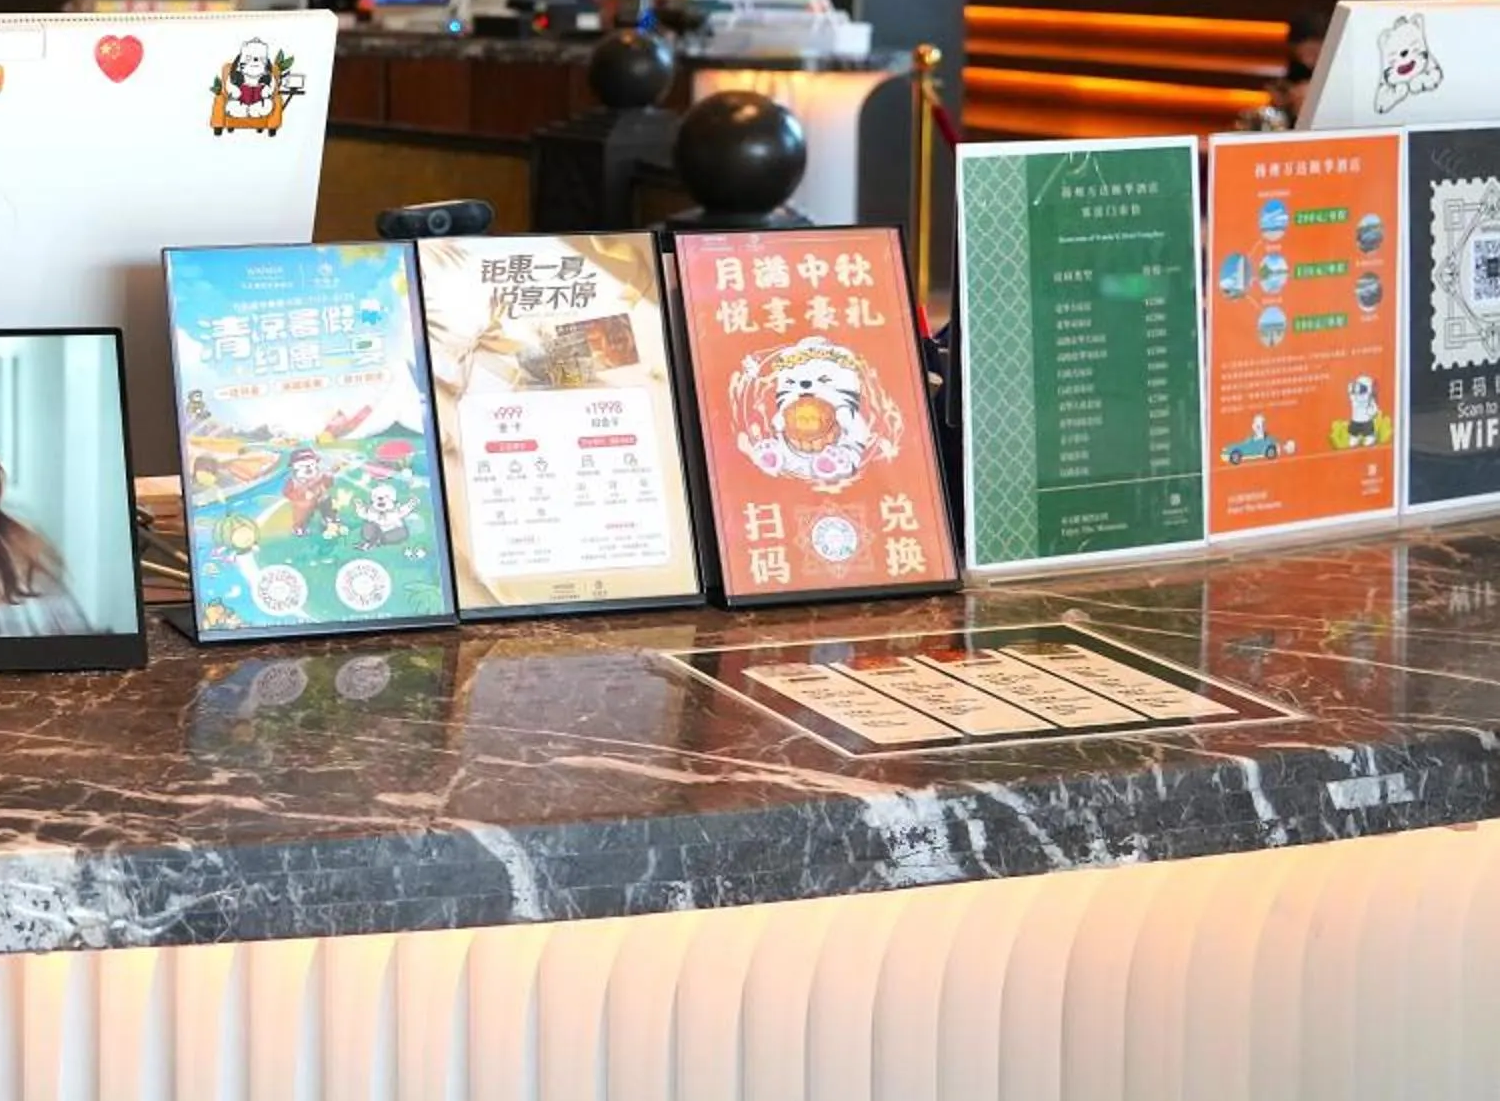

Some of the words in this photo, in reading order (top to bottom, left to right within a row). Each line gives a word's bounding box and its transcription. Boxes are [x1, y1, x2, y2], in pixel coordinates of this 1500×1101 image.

[481, 254, 597, 284] 钜惠一夏
[715, 254, 875, 292] 月满中秋
[491, 281, 597, 320] 悦享不停
[716, 297, 885, 335] 悦享豪礼
[743, 502, 791, 585] 扫码
[880, 494, 927, 577] 兑换
